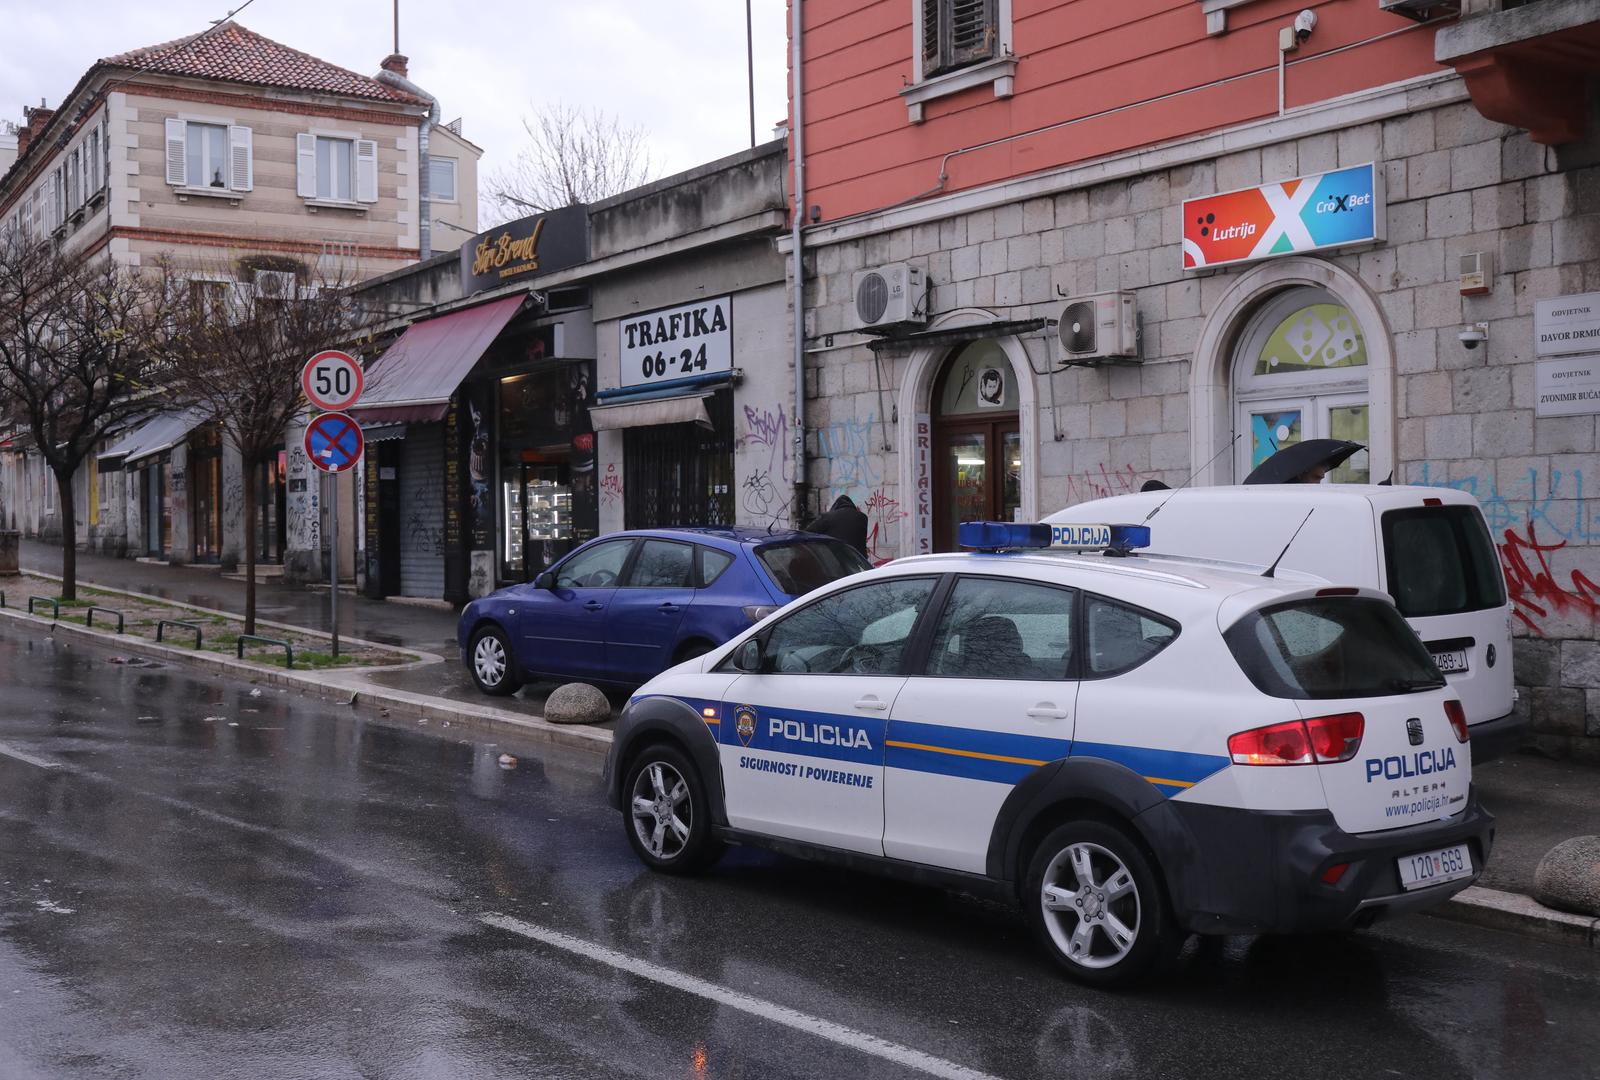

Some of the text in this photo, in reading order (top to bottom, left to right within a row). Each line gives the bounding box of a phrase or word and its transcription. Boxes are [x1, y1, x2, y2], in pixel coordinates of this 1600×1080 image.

[1213, 222, 1256, 242] Lutrija
[624, 304, 727, 349] TRAFIKA
[1551, 307, 1591, 317] ODVJETNIK
[1540, 332, 1570, 342] DAVOR
[642, 351, 666, 378] 06
[680, 342, 707, 372] 24
[1551, 370, 1592, 379] ODVJETNIK
[316, 366, 351, 396] 50
[1540, 392, 1577, 403] ZVONIMIR
[917, 422, 929, 529] BRIJAČKI
[1051, 526, 1110, 545] POLICIJA
[768, 717, 873, 751] POLICIJA
[739, 756, 874, 789] SIGURNOST I POVJERENJE
[1365, 747, 1457, 783] POLICIJA
[1385, 793, 1449, 817] www.policija.hr
[1411, 848, 1464, 881] 120 669
